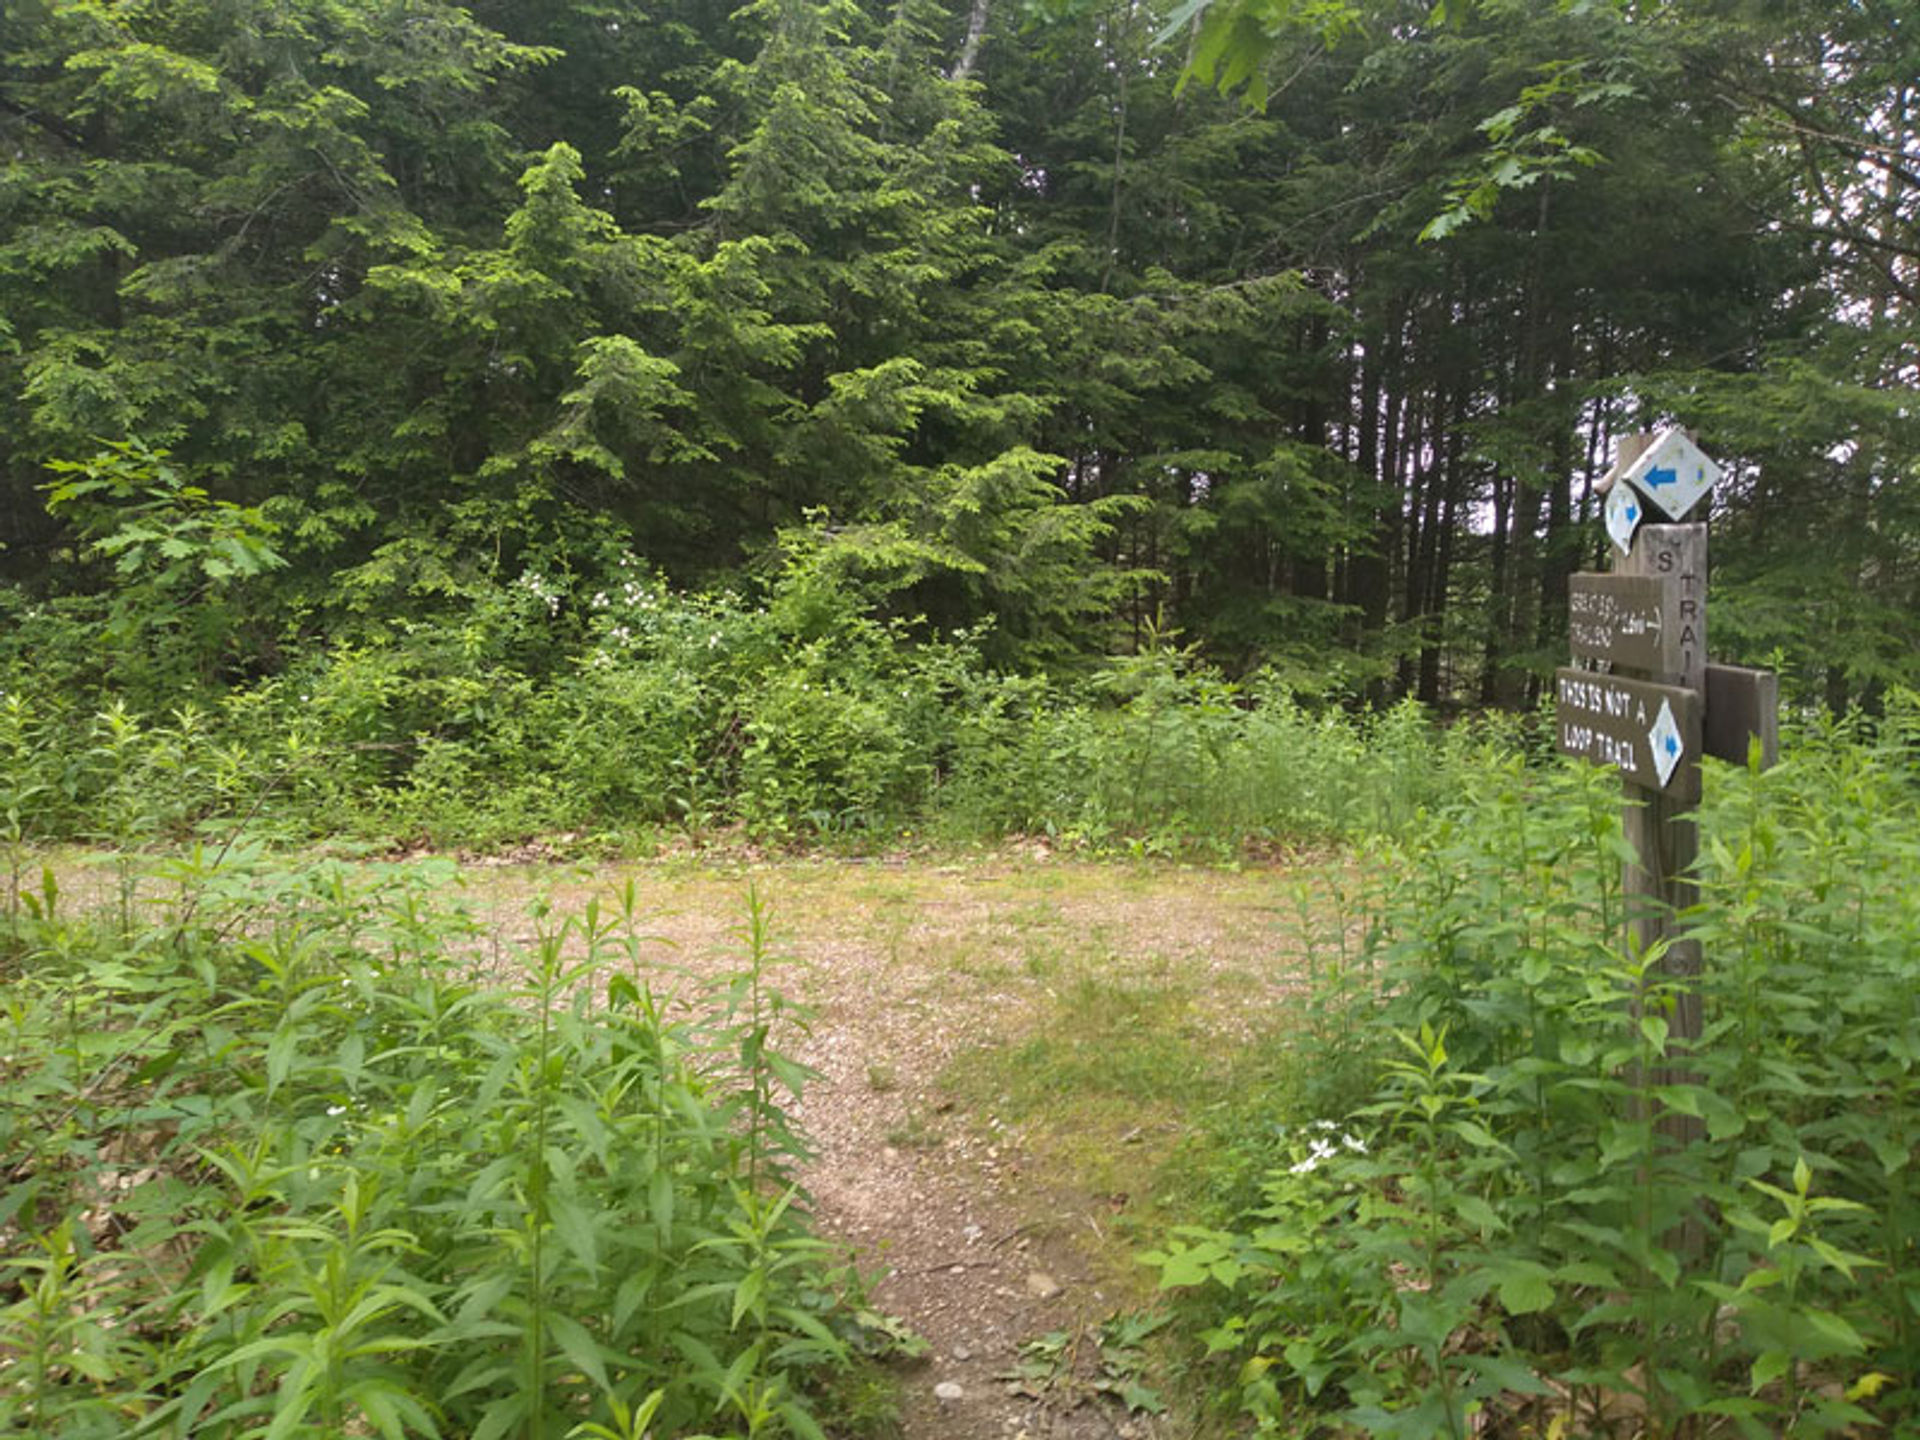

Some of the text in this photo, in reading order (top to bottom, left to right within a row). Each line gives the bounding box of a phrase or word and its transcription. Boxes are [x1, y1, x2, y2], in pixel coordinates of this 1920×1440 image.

[1560, 678, 1647, 726] THIS IS NOT A
[1564, 723, 1638, 772] LOOP TRAIL
